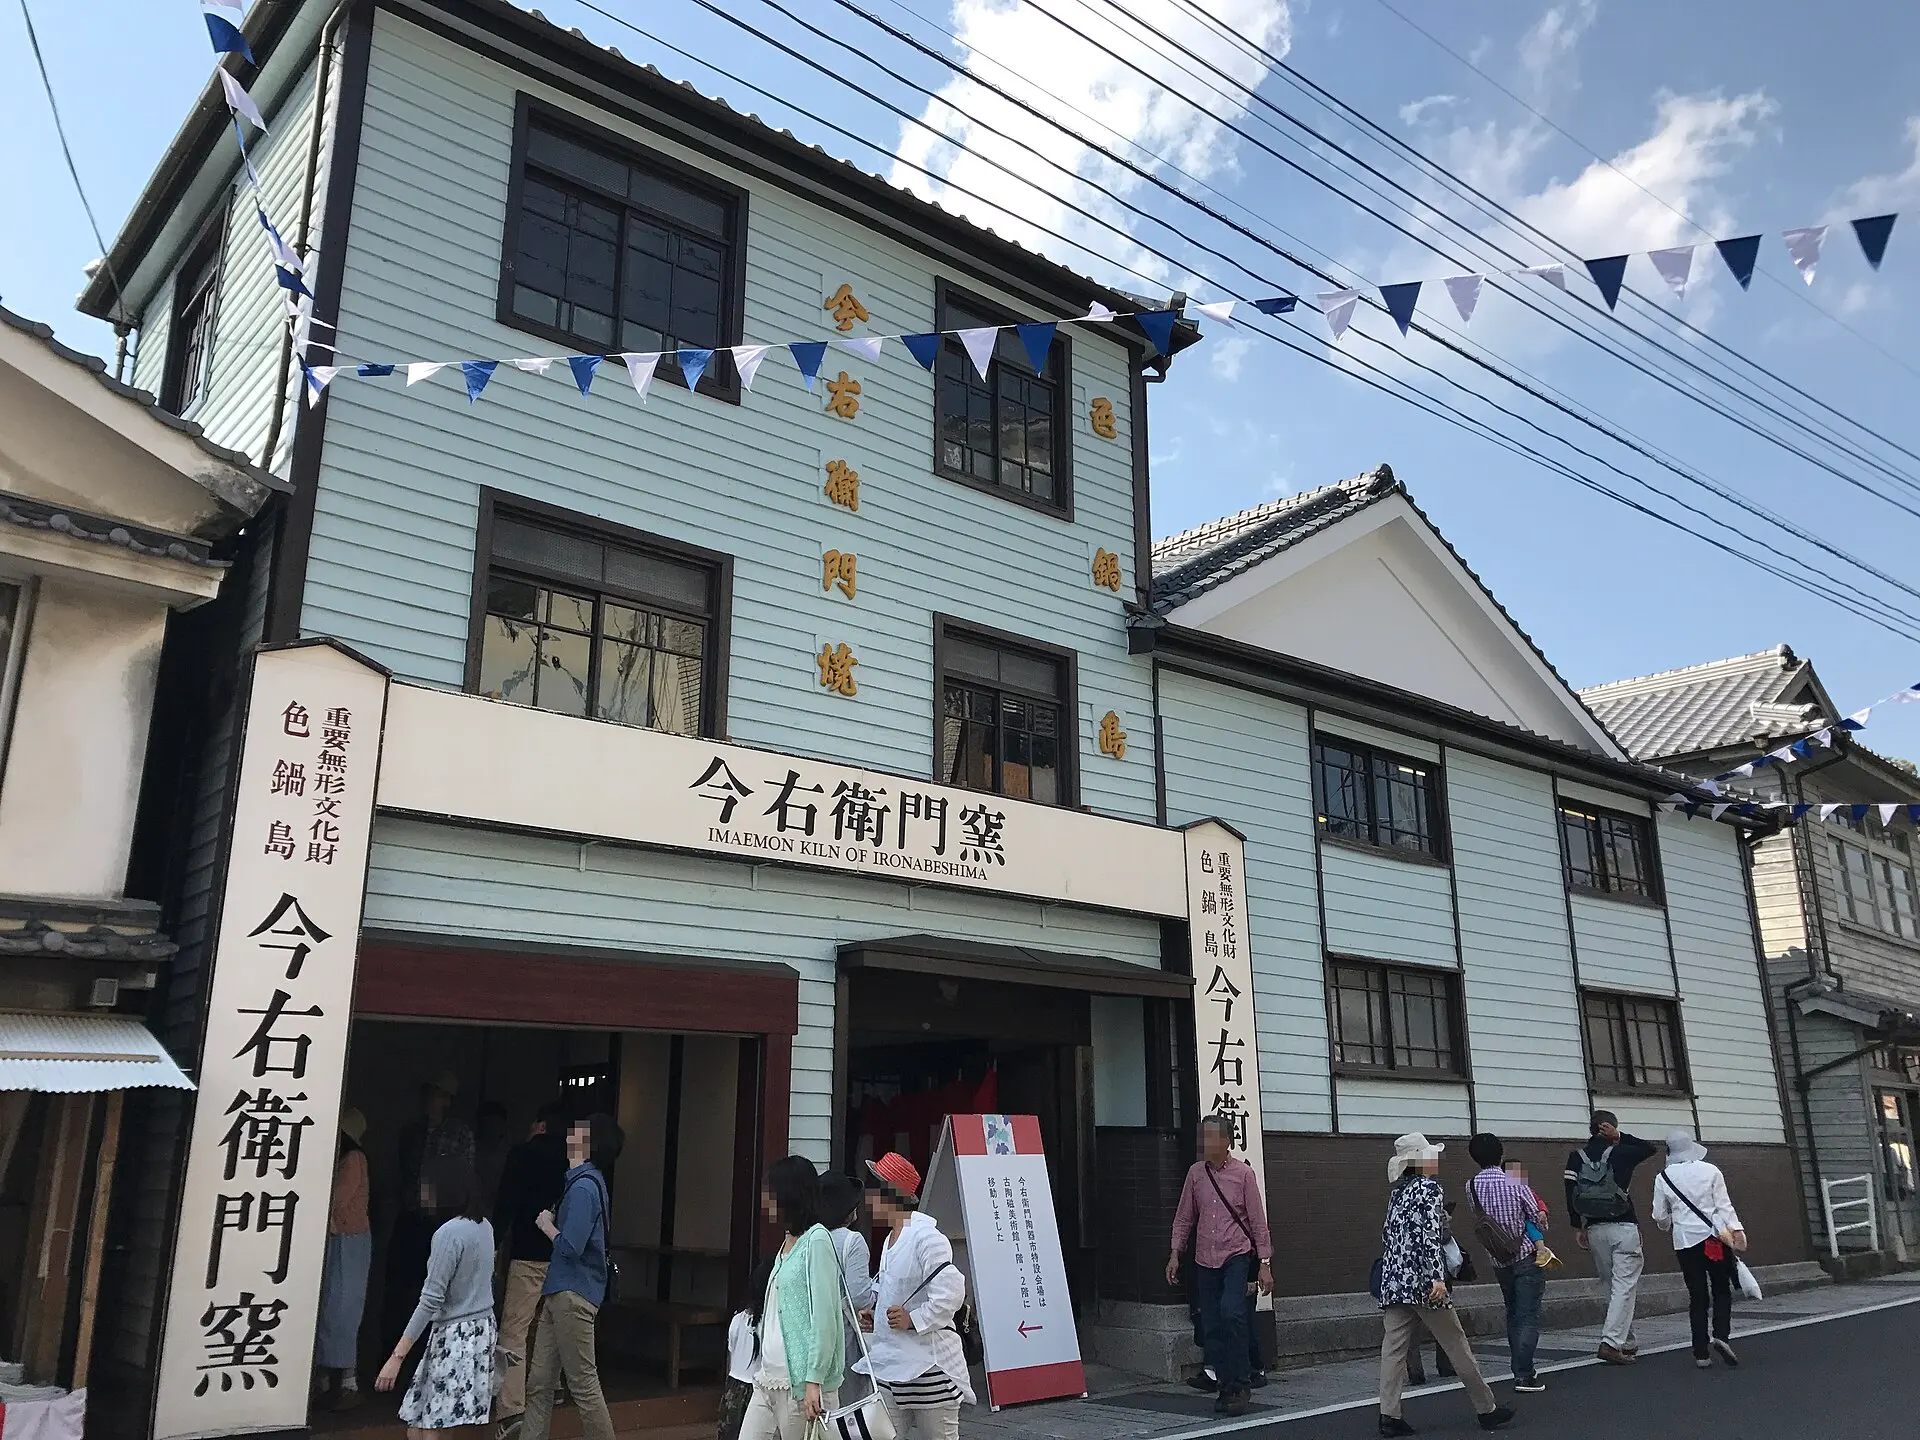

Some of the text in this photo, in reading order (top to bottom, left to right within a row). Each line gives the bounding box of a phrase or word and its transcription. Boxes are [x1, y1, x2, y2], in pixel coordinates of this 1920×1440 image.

[264, 699, 310, 861] 色鍋島
[304, 706, 352, 866] 重要無形文化財
[688, 755, 1007, 867] 今右衛門窯
[707, 826, 988, 881] IMAEMON KILN OF IRONABESHIMA
[1200, 849, 1218, 958] 色鍋島
[1217, 851, 1237, 960] 重要無形文化財
[193, 892, 333, 1398] 今右衛門窯
[987, 1176, 1004, 1243] 移動しました
[1018, 1176, 1047, 1308] 今右衛門陶器市特設会場は
